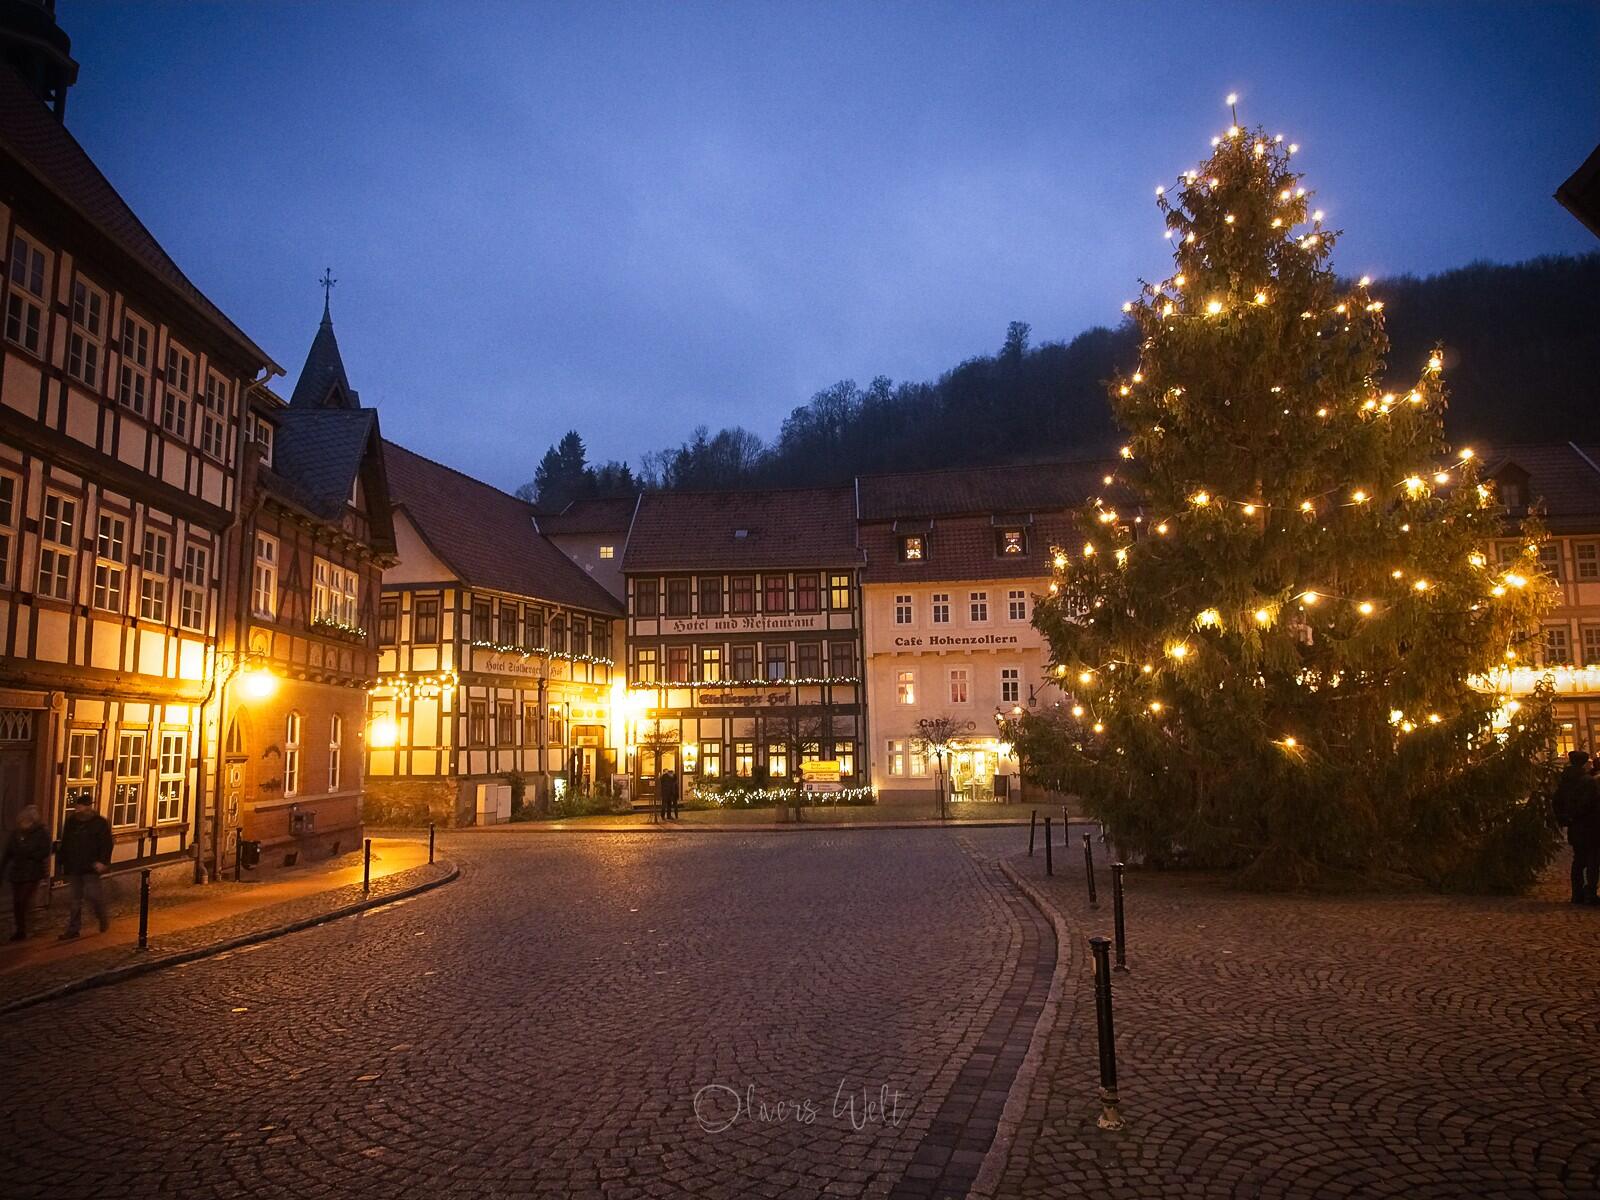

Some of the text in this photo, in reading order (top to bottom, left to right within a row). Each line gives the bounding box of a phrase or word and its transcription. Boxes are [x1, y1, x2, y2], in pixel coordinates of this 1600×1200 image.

[673, 619, 709, 632] Hotel
[715, 619, 738, 630] und
[894, 635, 1018, 646] Café Hohenzollern
